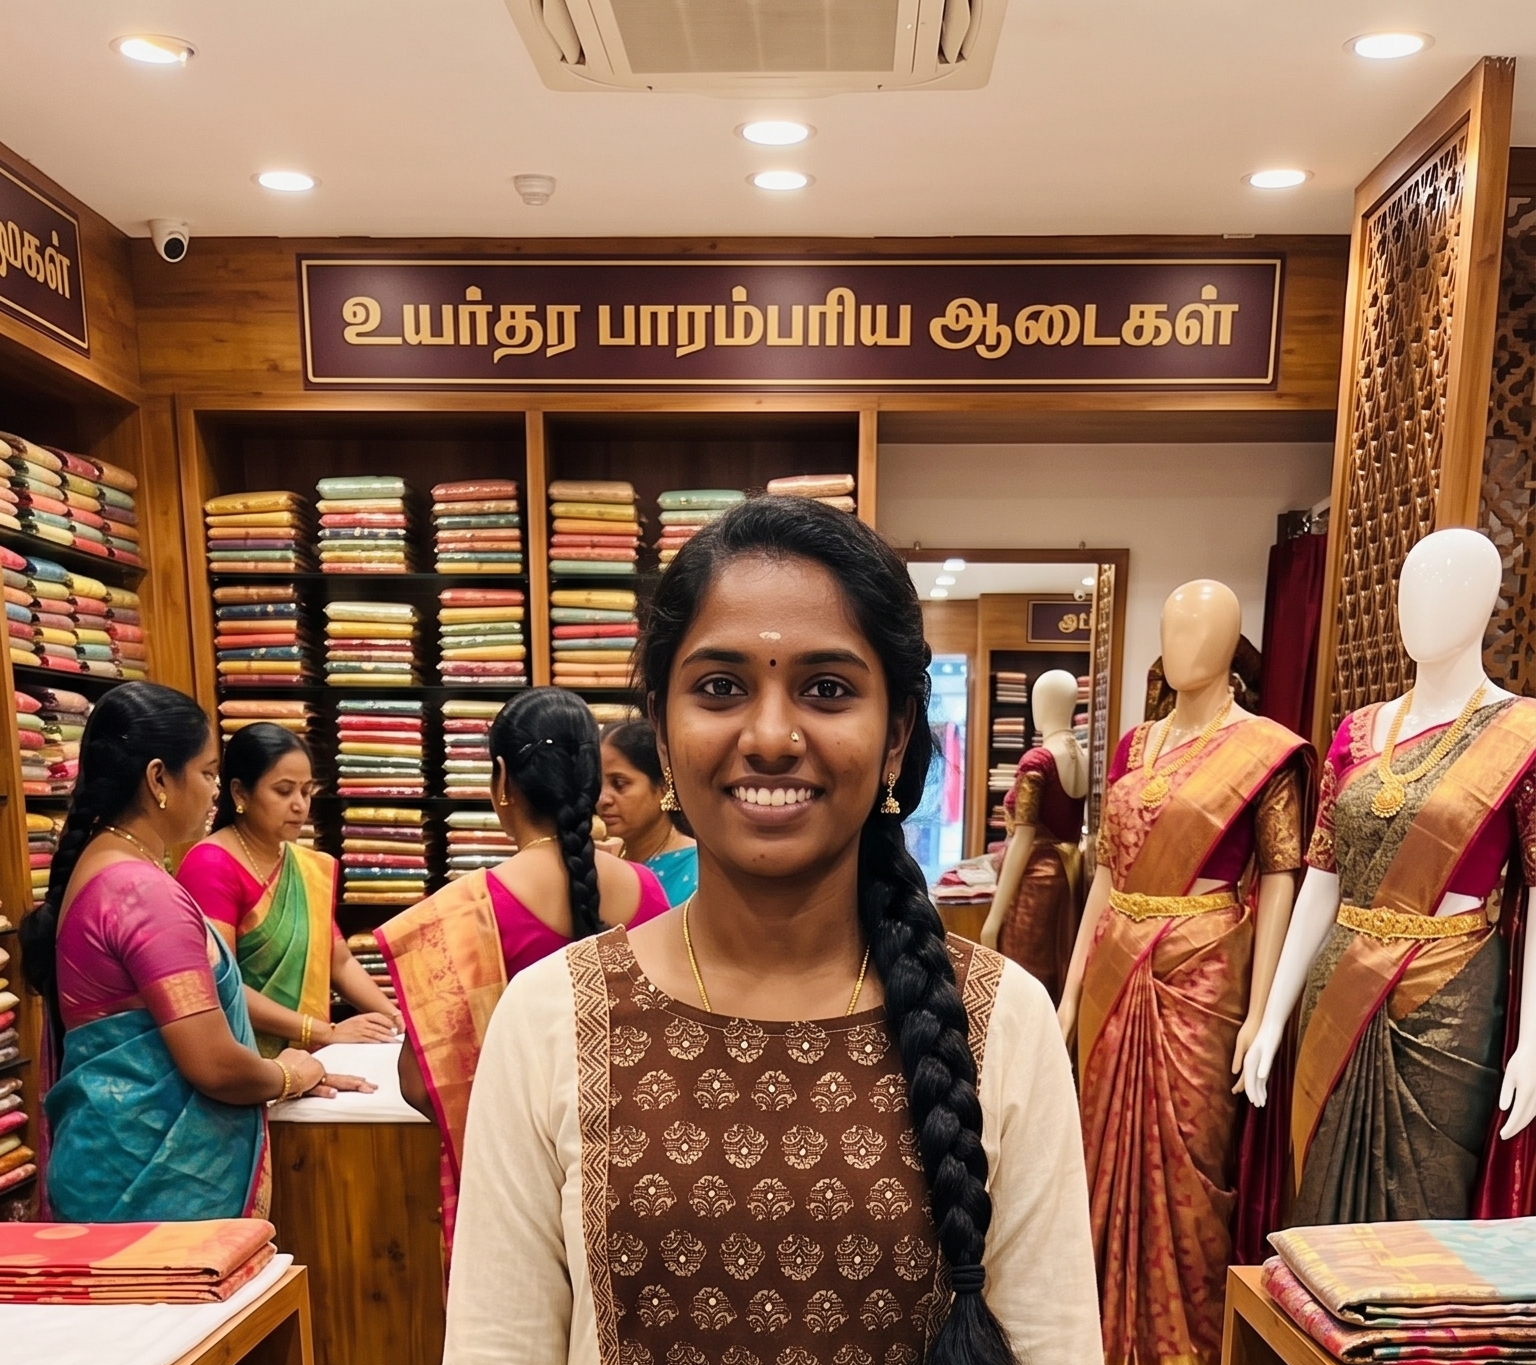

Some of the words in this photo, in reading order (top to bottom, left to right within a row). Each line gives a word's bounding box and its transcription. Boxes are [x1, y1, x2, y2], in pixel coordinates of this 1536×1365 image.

[342, 285, 581, 364] உயர்தர
[598, 285, 912, 358] பாரம்பரிய
[929, 284, 1239, 359] ஆடைகள்
